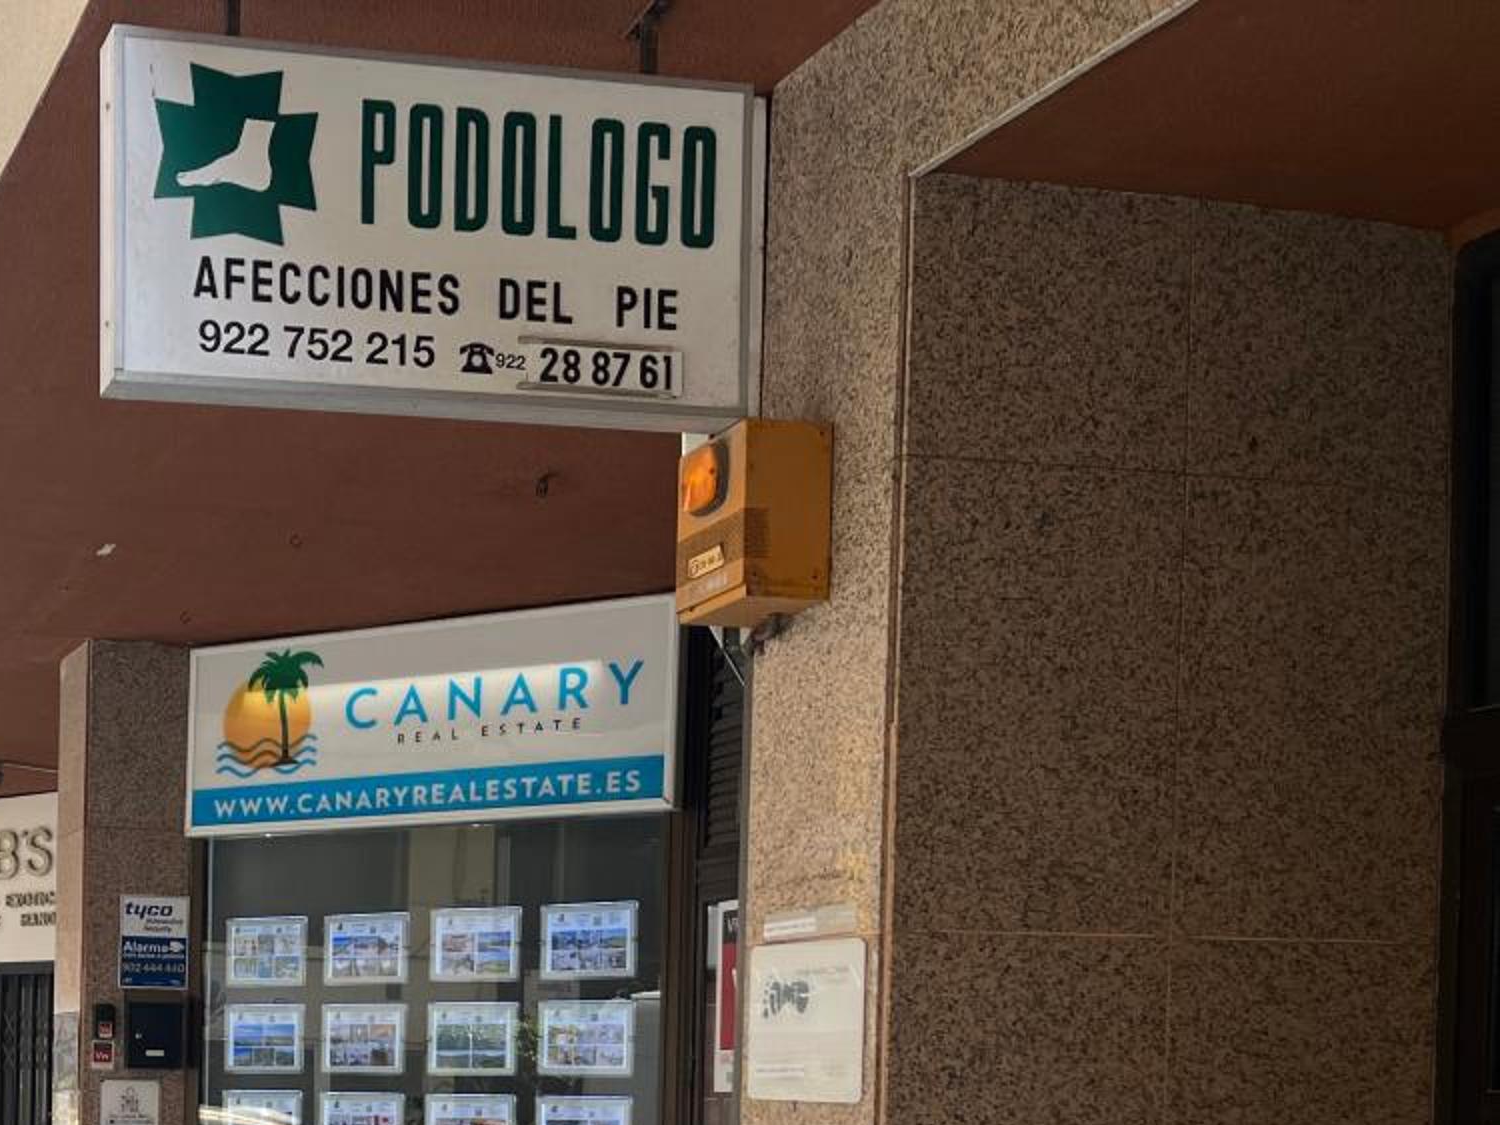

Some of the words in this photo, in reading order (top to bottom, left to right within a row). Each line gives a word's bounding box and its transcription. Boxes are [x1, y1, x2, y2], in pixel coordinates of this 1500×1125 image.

[361, 99, 716, 249] PODOLOGO
[194, 256, 460, 316] AFECCIONES
[500, 278, 573, 325] DEL
[616, 286, 679, 330] PIE
[199, 320, 270, 356] 922
[283, 326, 353, 362] 752
[366, 332, 435, 367] 215
[495, 353, 526, 370] 922
[539, 347, 581, 384] 28
[591, 352, 631, 387] 87
[638, 355, 673, 390] 61
[346, 659, 644, 729] CANARY
[397, 729, 459, 744] REAL
[481, 717, 583, 737] ESTATE
[214, 770, 642, 818] WWW.CANARYREALESTATE.ES
[125, 902, 173, 919] tyco
